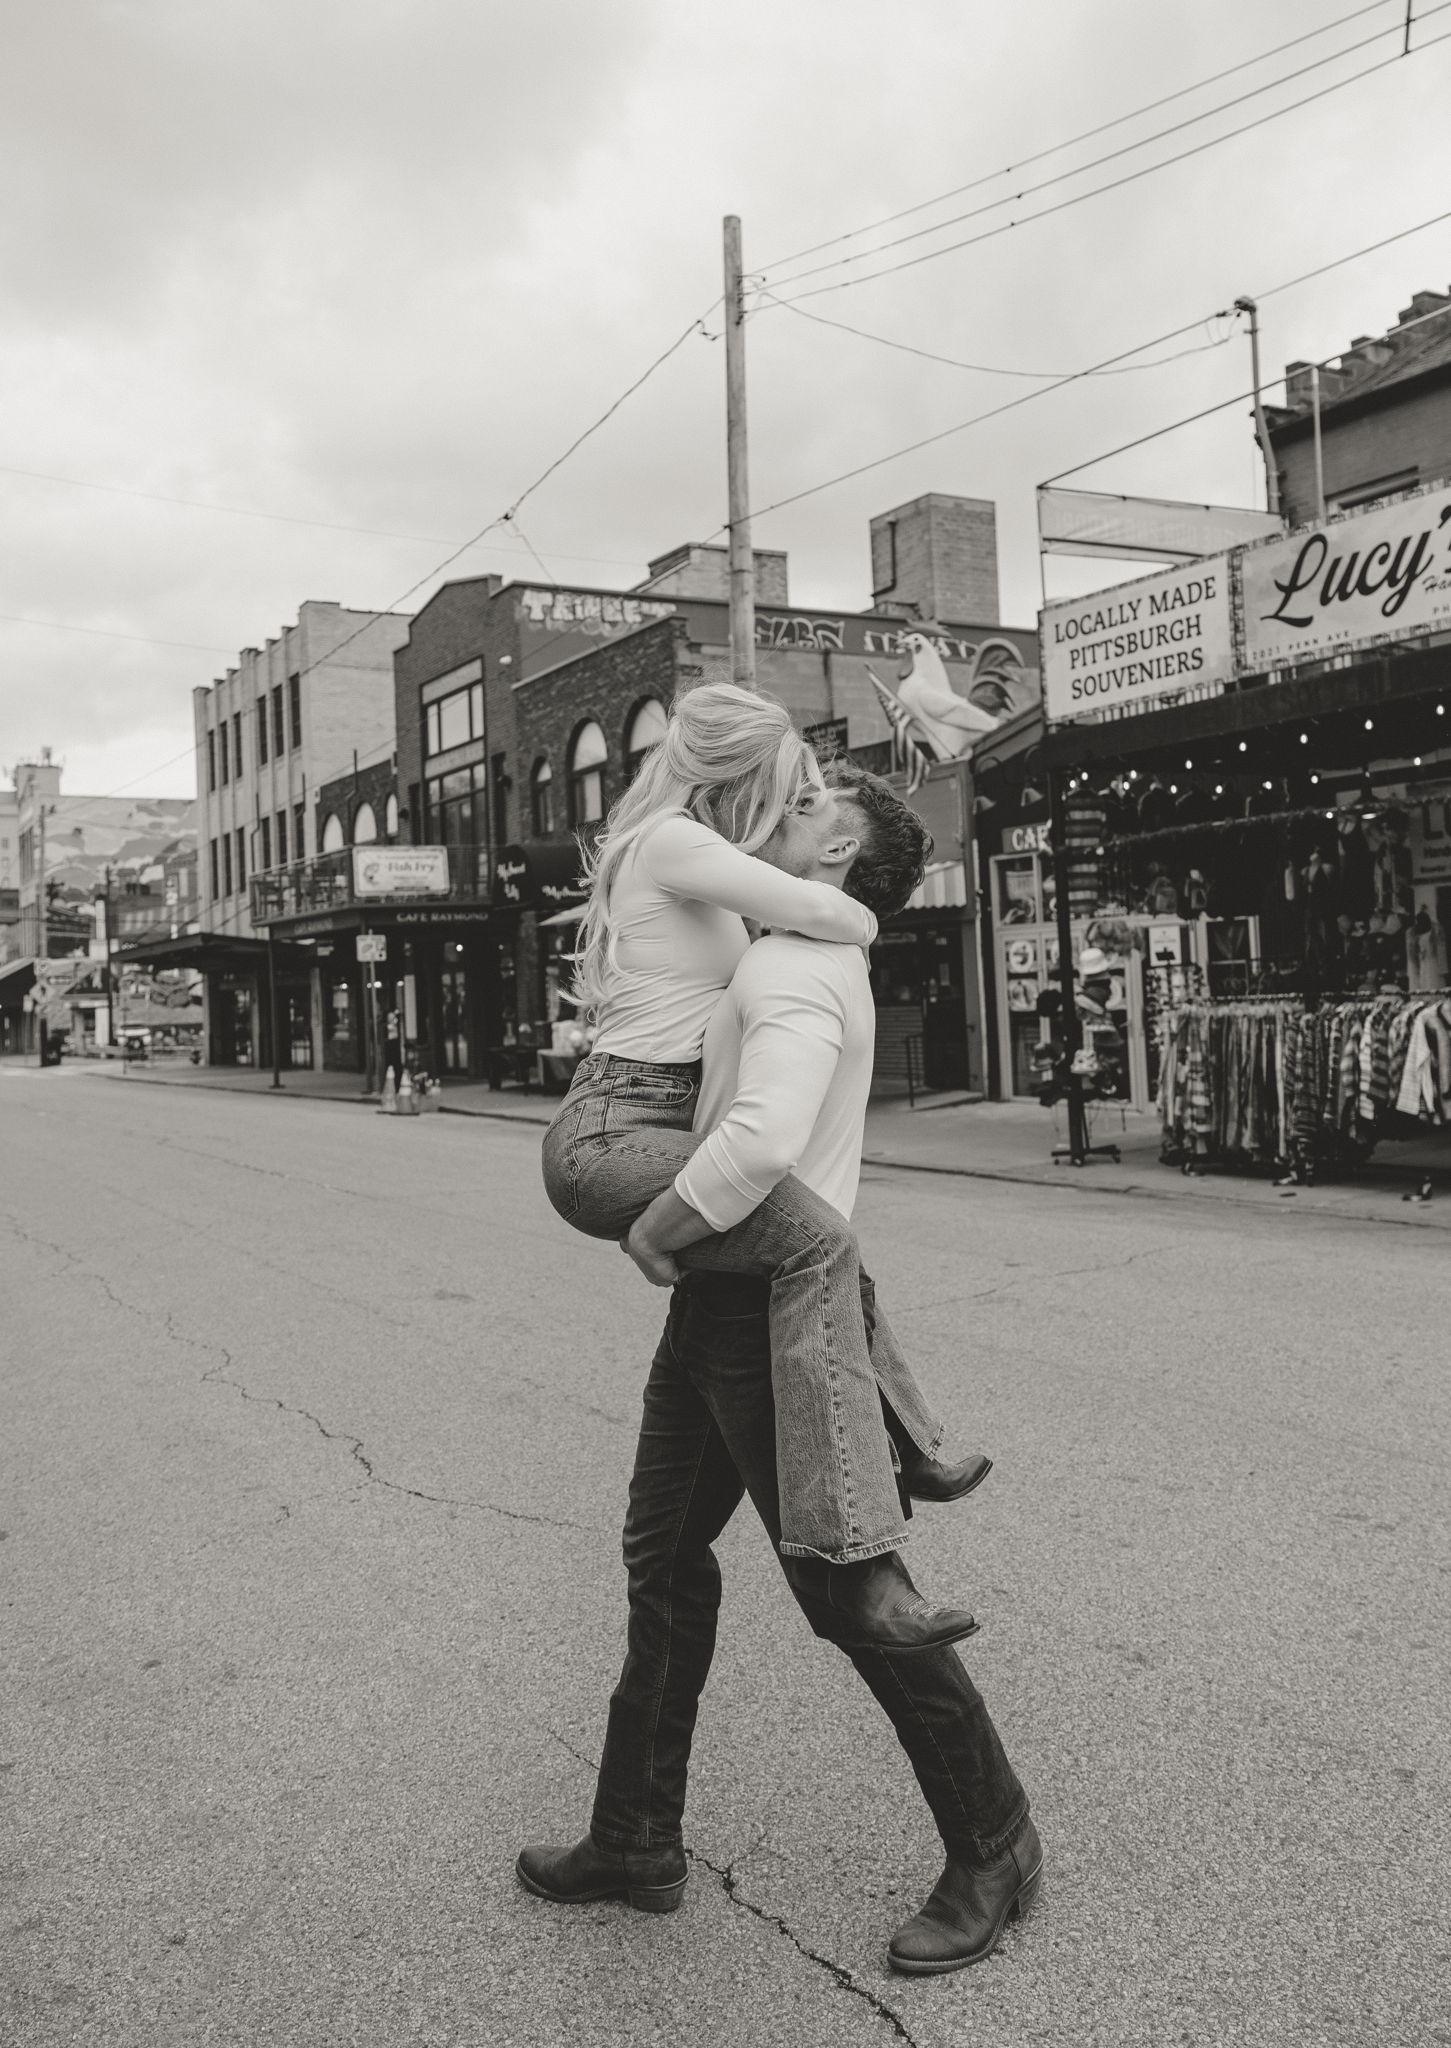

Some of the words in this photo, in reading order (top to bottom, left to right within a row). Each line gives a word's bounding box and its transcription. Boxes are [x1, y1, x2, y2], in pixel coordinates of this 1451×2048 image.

[1054, 598, 1142, 644] LOCALLY
[1149, 575, 1217, 616] MADE
[1069, 613, 1203, 670] PITTSBURGH
[1071, 646, 1204, 700] SOUVENIERS
